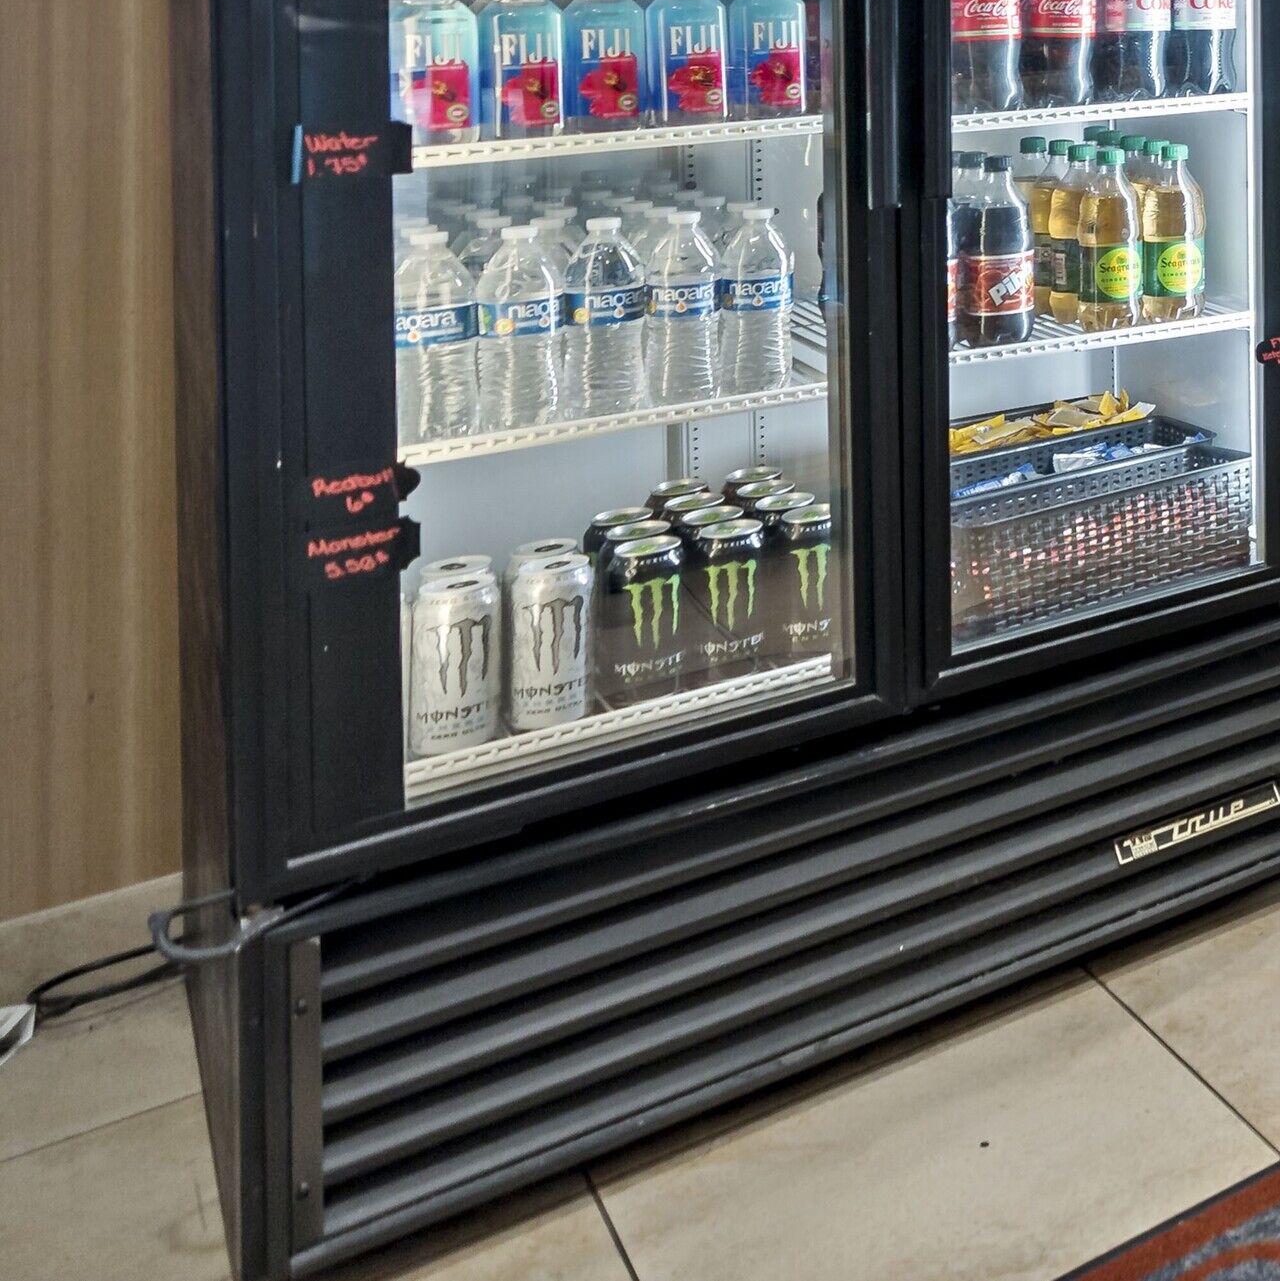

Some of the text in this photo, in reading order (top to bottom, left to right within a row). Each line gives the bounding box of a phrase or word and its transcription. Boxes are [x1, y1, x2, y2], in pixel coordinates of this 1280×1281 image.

[404, 32, 464, 67] FIJI
[500, 32, 554, 67] FIJI
[580, 27, 632, 60] FIJI
[669, 24, 719, 56] FIJI
[752, 20, 799, 51] FIJI
[304, 130, 379, 154] Water
[307, 526, 400, 559] Monster
